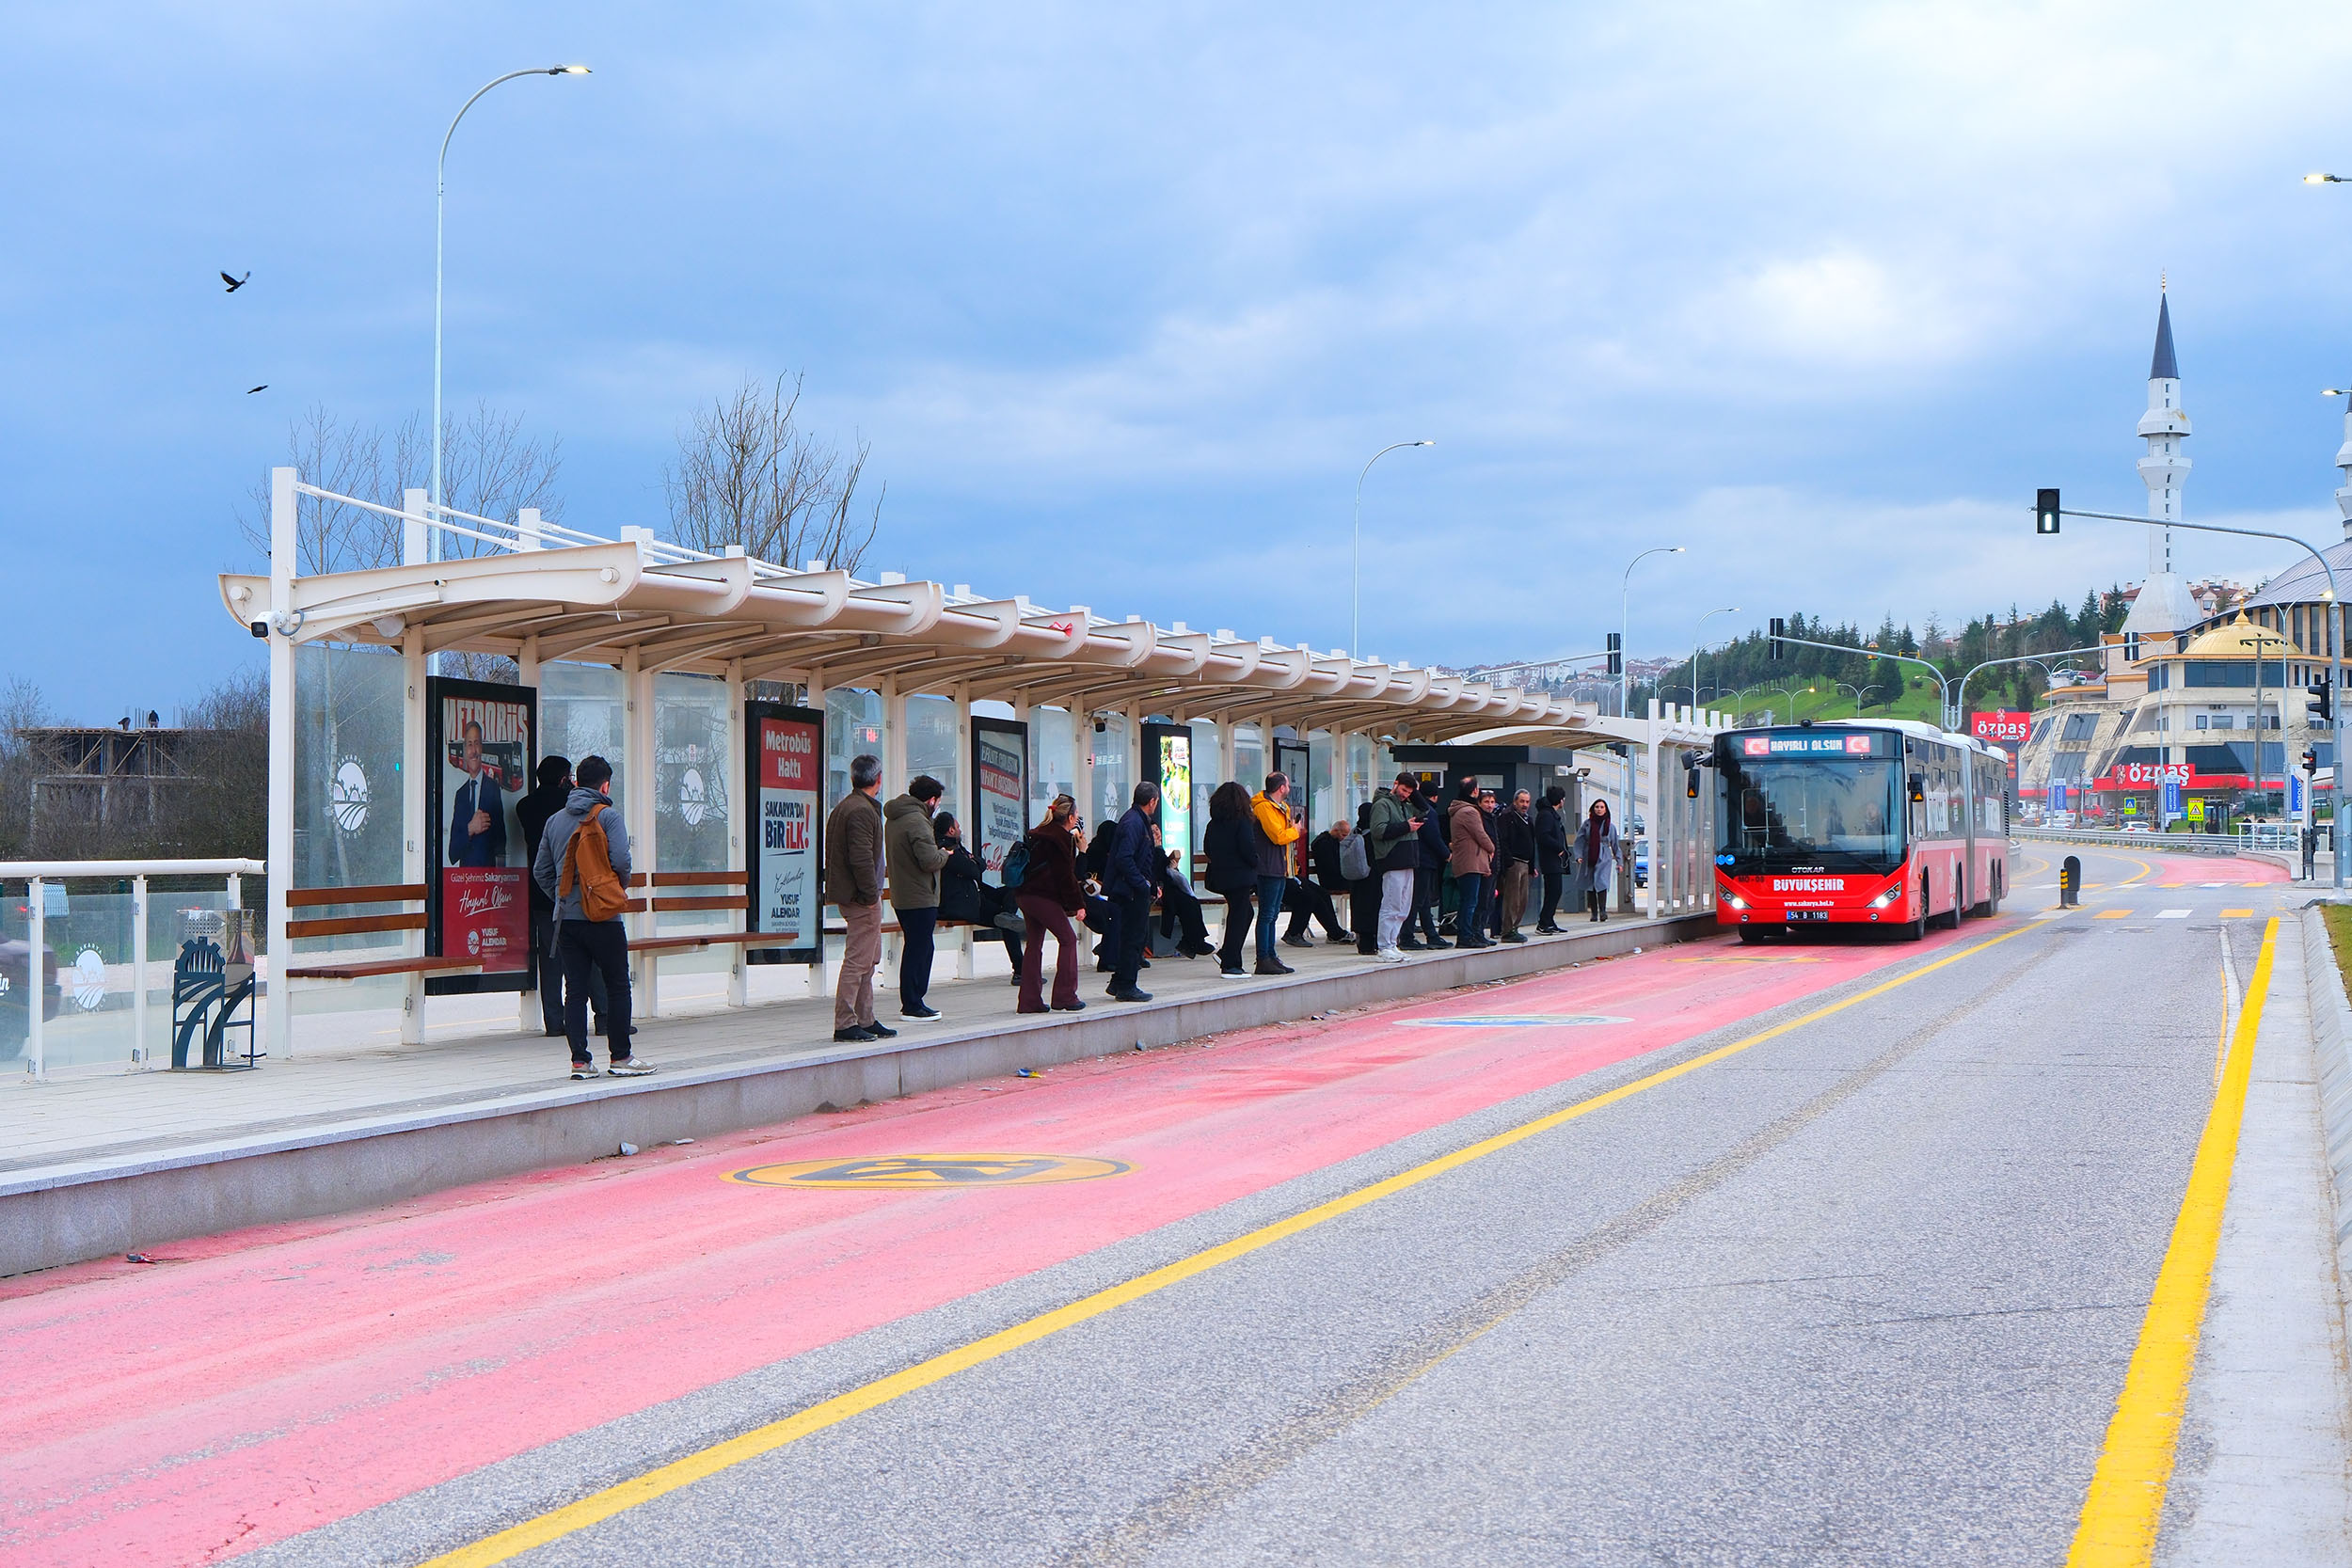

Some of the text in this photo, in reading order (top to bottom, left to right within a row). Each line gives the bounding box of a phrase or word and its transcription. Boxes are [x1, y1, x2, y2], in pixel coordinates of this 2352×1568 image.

[443, 698, 529, 747] METROBÜS
[1978, 721, 2026, 737] özpaş
[766, 730, 811, 753] Metrobüs
[1811, 739, 1843, 751] OLSUN
[338, 754, 365, 769] SAKARYA
[778, 757, 801, 779] Hattı
[765, 800, 804, 818] SAKARYA'DA
[765, 804, 810, 848] BİR İLK!
[1773, 879, 1844, 893] BÜYÜKŞEHİR
[780, 894, 799, 905] YUSUF
[482, 927, 499, 937] YUSUF
